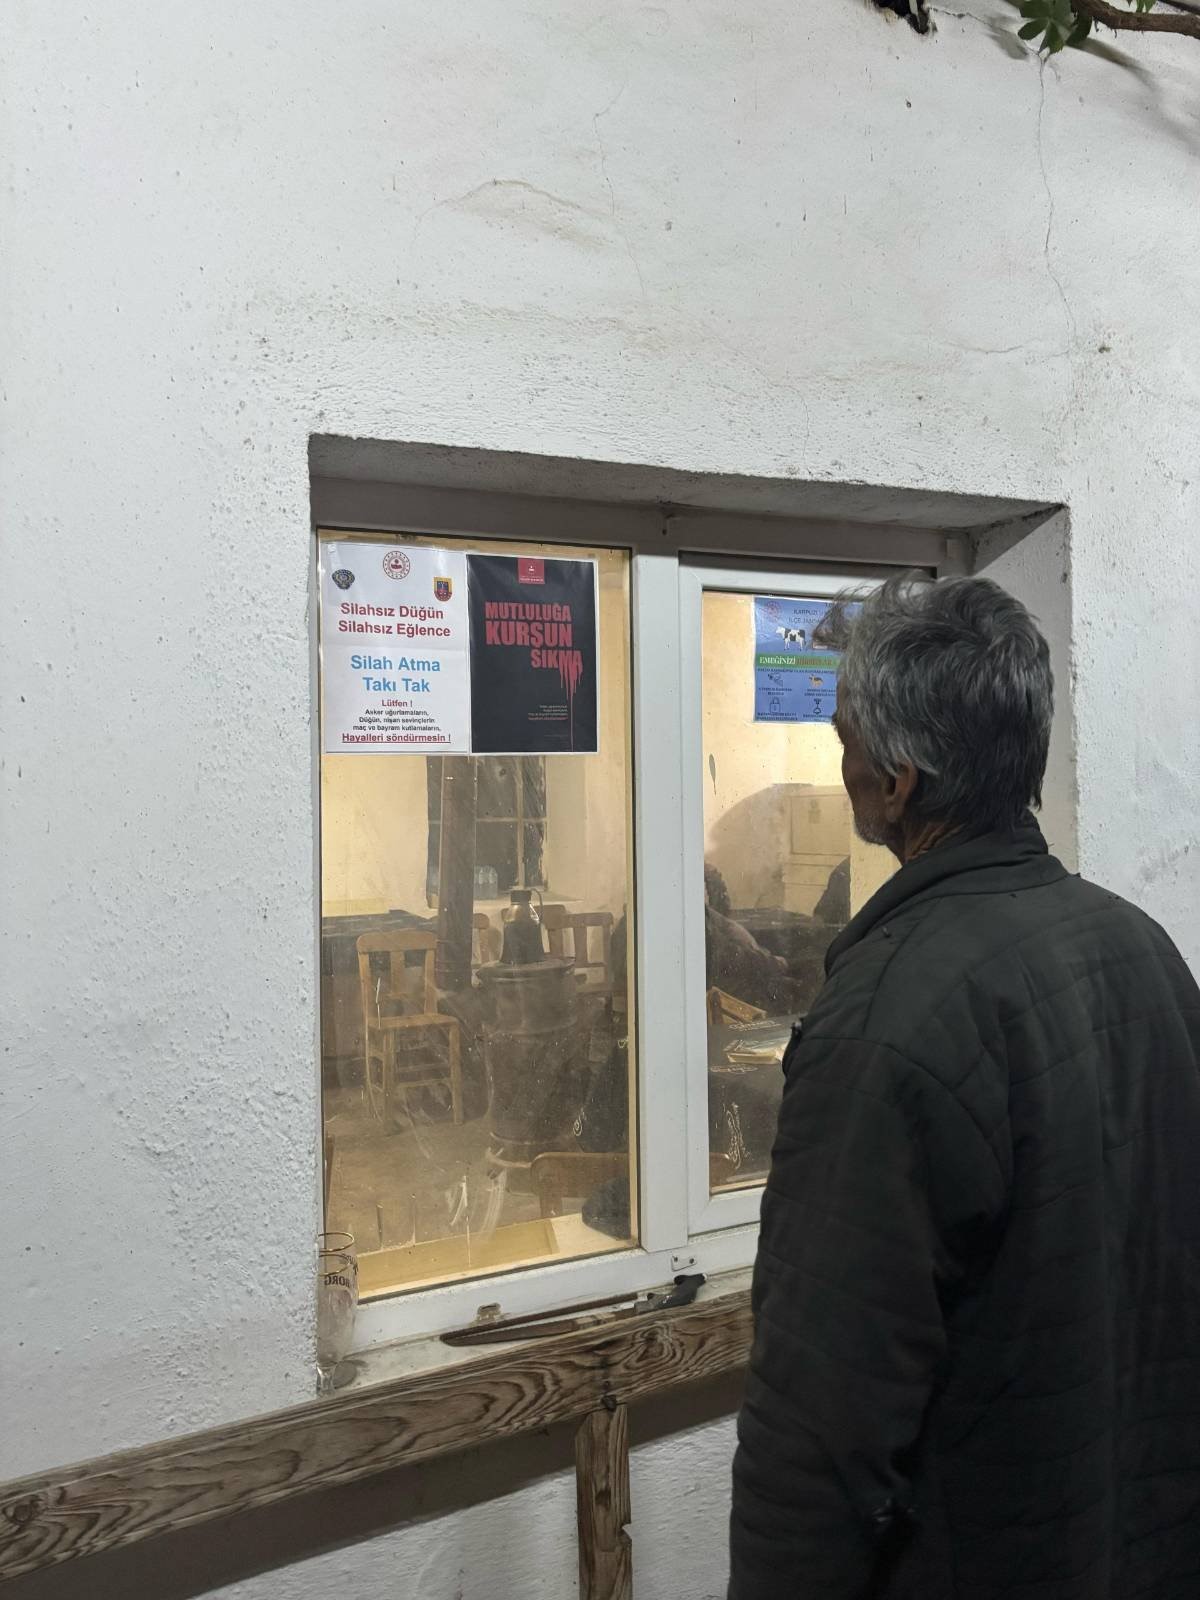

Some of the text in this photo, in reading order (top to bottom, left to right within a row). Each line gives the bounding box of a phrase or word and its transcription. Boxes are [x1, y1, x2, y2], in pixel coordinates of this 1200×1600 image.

[340, 602, 444, 621] Silahsız Düğün
[338, 620, 451, 638] Silahsız Eğlence
[485, 620, 573, 648] KURŞUN
[350, 655, 441, 672] Silah Atma
[362, 677, 431, 692] Takı Tak
[342, 733, 384, 742] Hayalleri
[386, 733, 446, 742] söndürmesin
